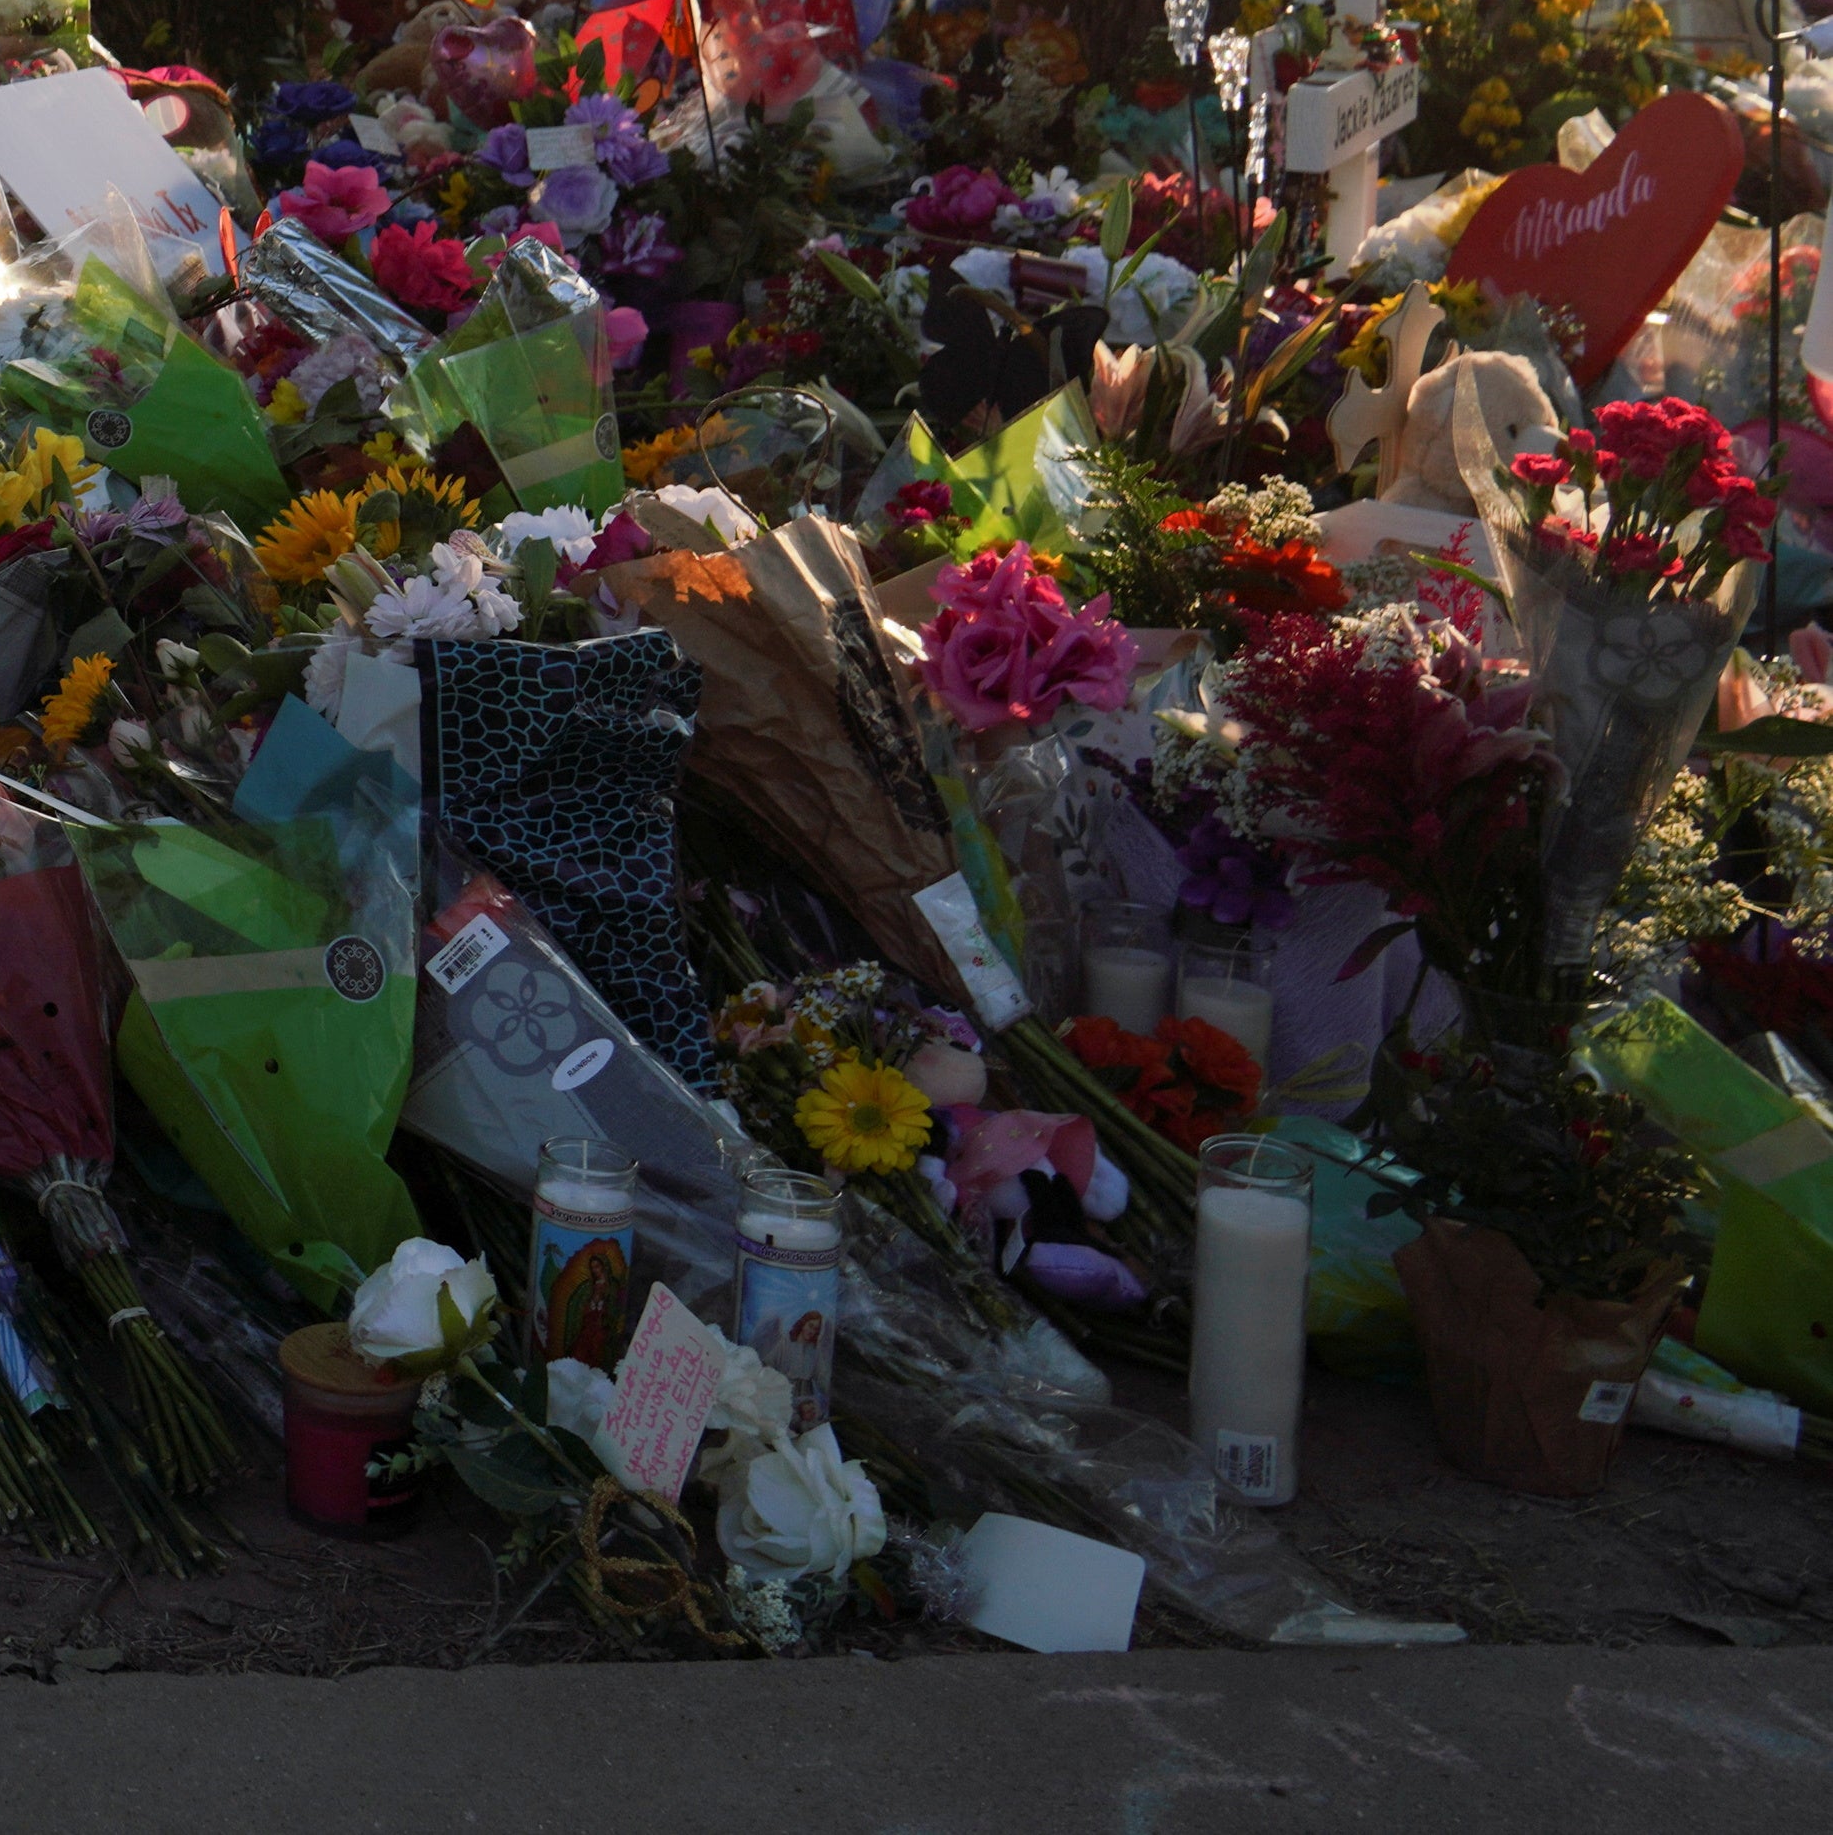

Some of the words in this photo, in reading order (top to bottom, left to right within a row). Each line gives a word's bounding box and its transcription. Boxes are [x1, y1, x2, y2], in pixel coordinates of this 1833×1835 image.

[1333, 95, 1368, 150] Jackie
[1503, 149, 1657, 260] Miranda
[566, 1050, 598, 1078] RAINBOW
[551, 1207, 582, 1223] Virgen
[583, 1215, 596, 1223] de
